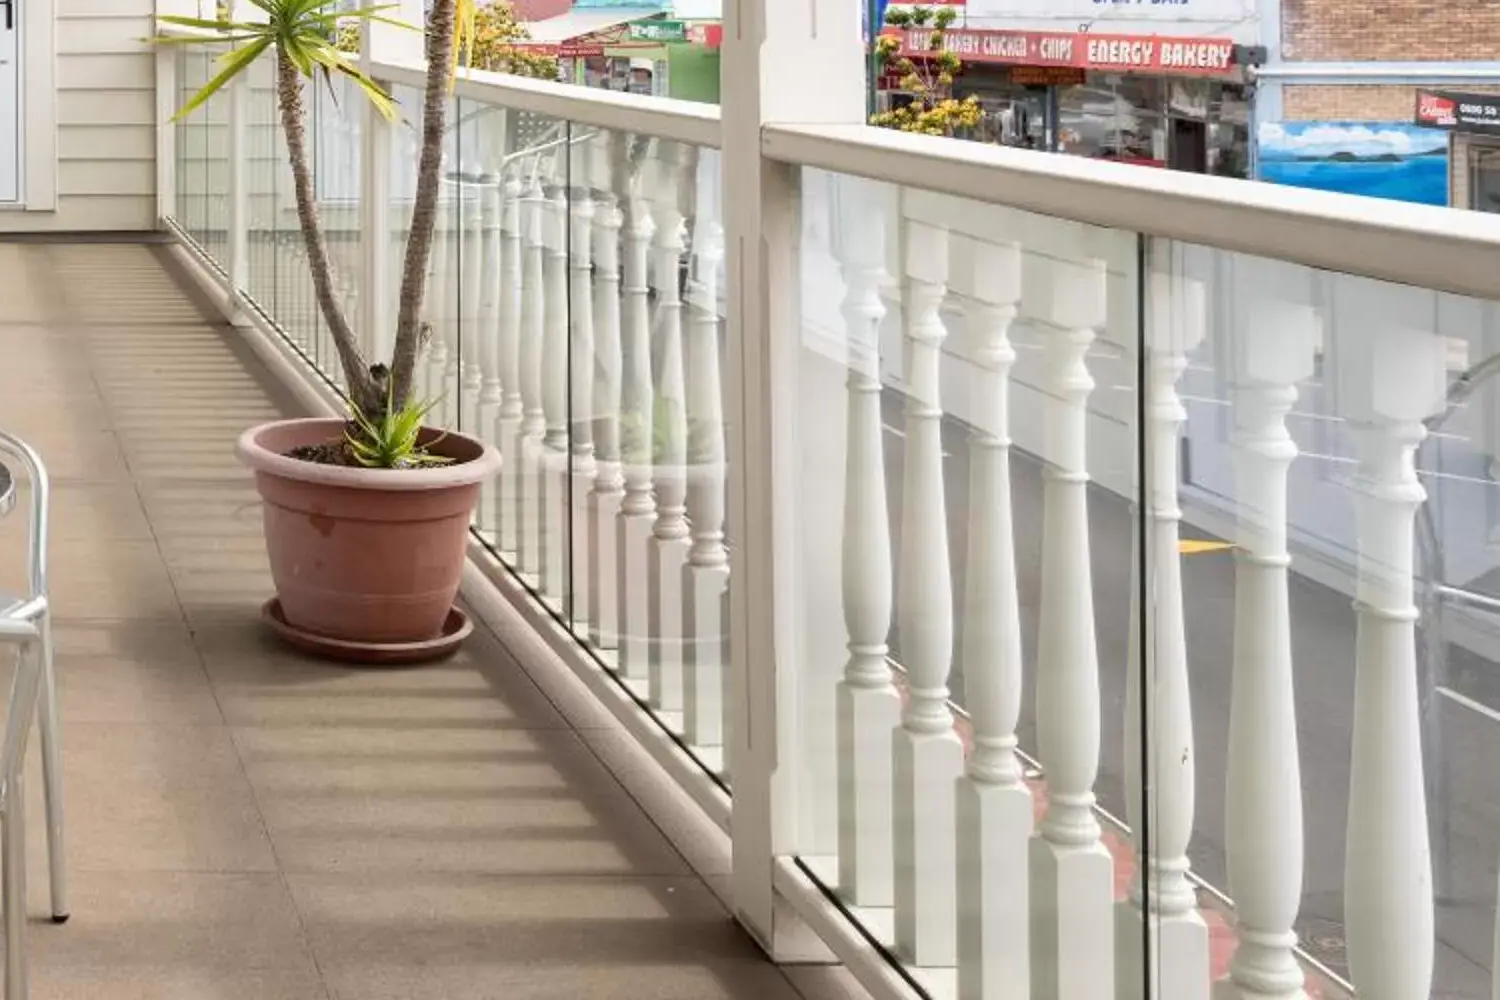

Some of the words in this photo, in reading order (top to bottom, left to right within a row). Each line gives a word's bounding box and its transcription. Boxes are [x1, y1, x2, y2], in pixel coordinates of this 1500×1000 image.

[1039, 37, 1074, 60] CHIPS
[1087, 39, 1154, 66] ENERGY
[1160, 42, 1232, 69] BAKERY
